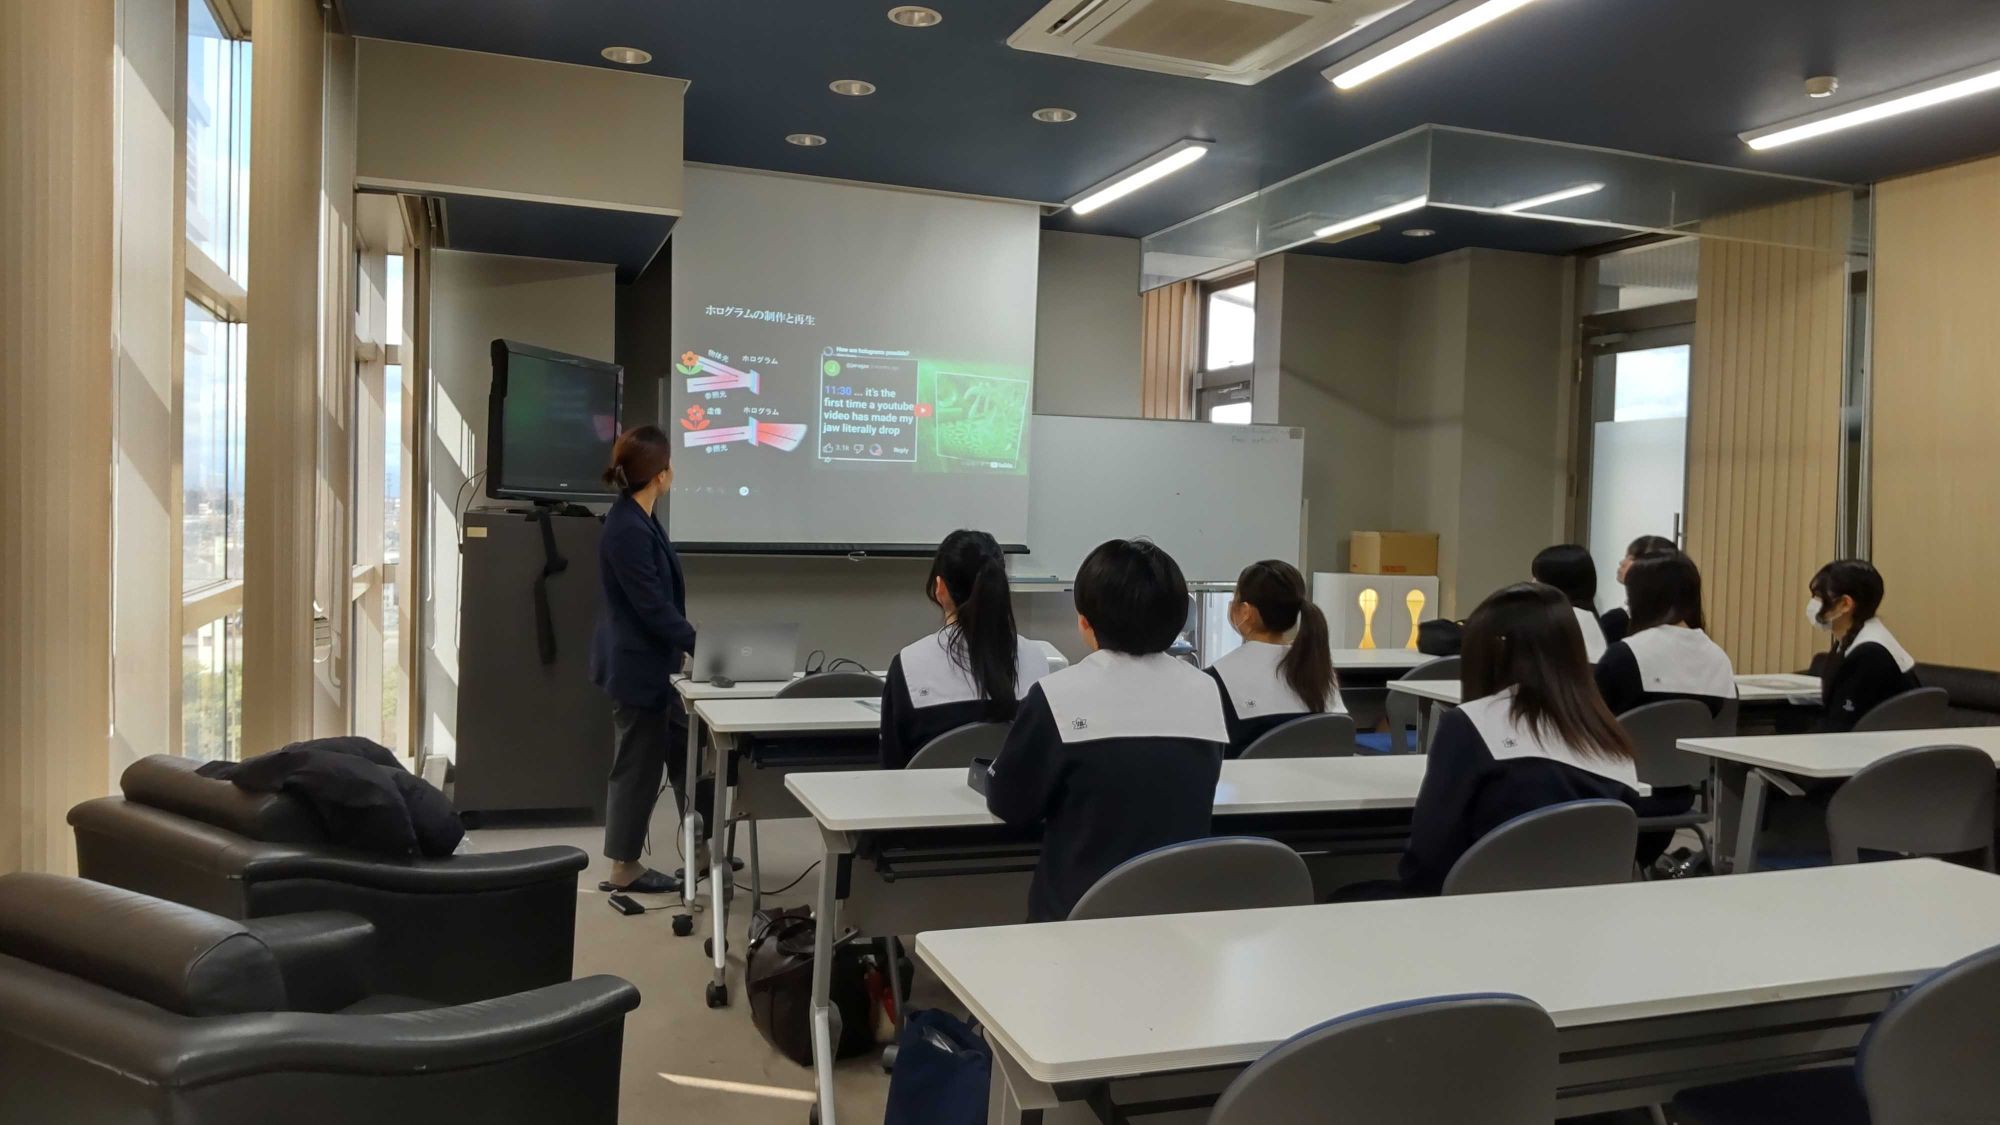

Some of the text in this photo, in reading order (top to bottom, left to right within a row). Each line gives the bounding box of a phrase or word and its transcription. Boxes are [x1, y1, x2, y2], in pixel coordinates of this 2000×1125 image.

[705, 305, 816, 326] ホログラムの制作と再生
[742, 355, 779, 365] ホログラム
[825, 386, 852, 396] 11:30
[865, 387, 879, 398] it's
[881, 388, 896, 398] the
[743, 406, 779, 416] ホログラム
[824, 397, 844, 408] first
[846, 399, 867, 409] time
[877, 401, 914, 411] youtube
[824, 410, 914, 425] video has made my
[822, 422, 900, 436] jaw literally drop
